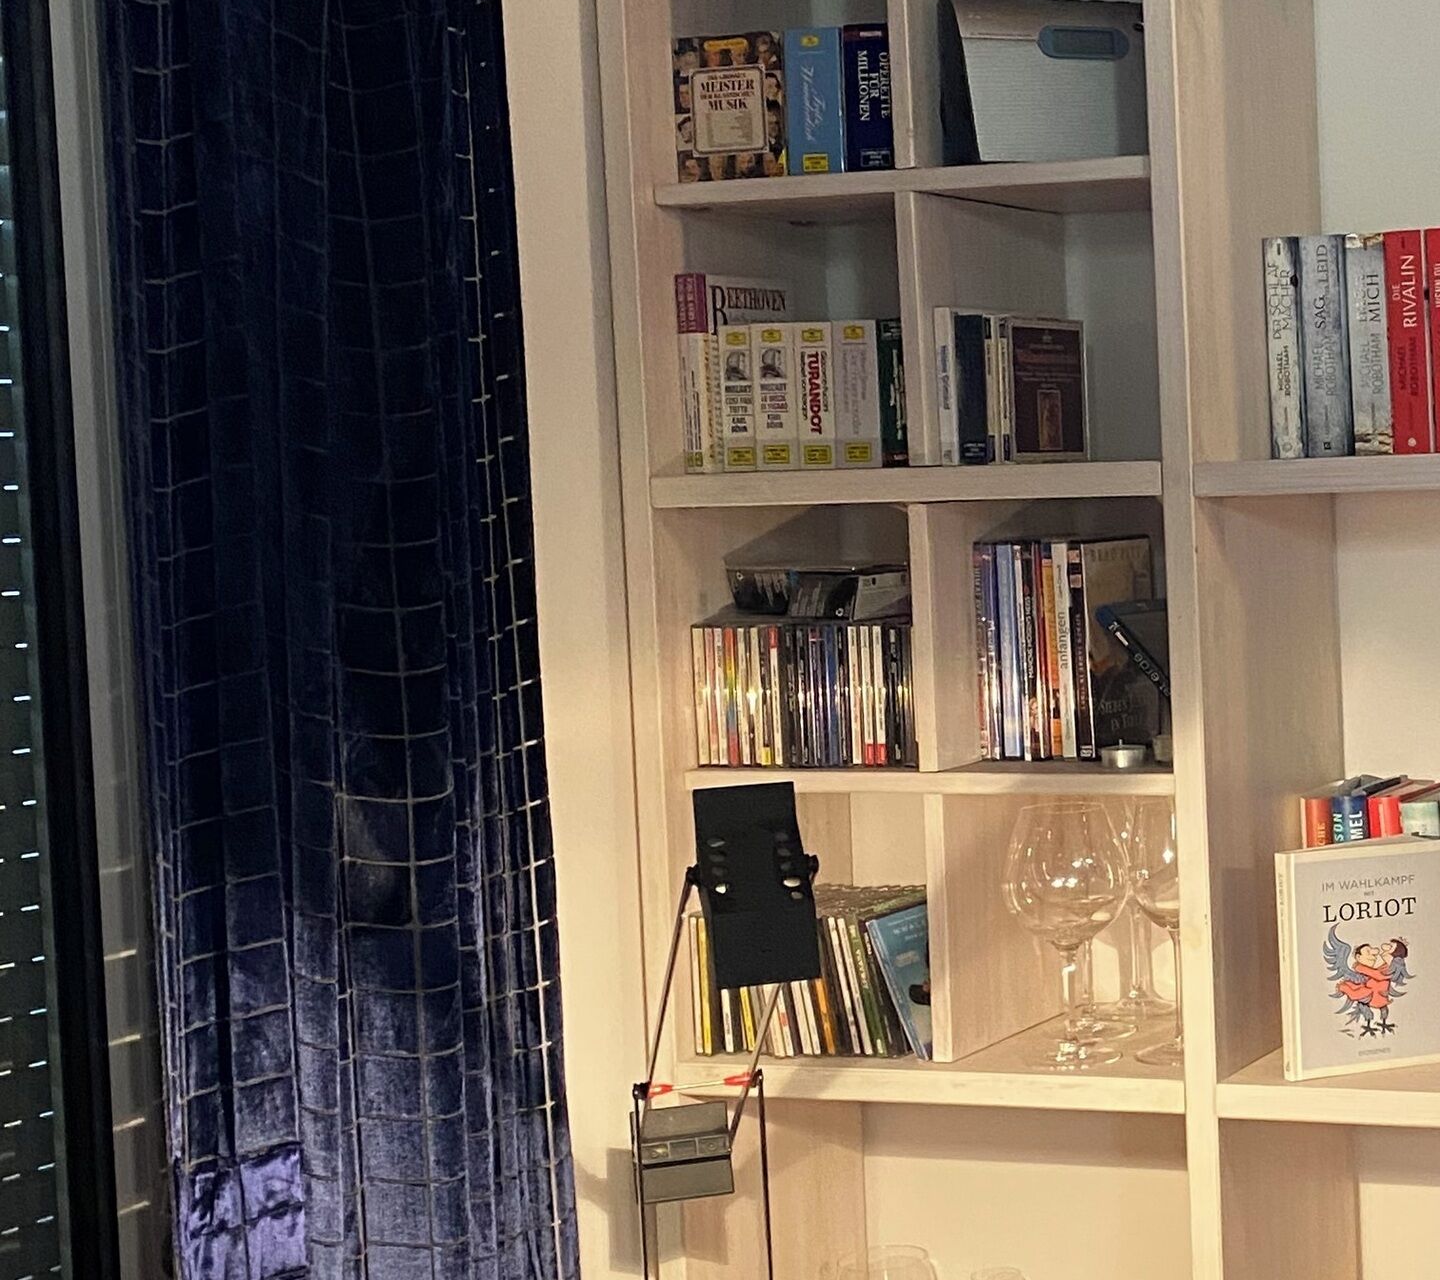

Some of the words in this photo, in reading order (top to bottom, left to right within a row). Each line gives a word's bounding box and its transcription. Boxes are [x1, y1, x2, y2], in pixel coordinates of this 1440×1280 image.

[708, 98, 748, 111] MUSIK
[857, 50, 871, 121] MILLIONEN
[869, 72, 879, 99] FÜR
[1317, 245, 1329, 282] LEID
[1367, 274, 1381, 322] MICH
[1400, 255, 1417, 327] RIVALIN
[807, 351, 823, 435] TURANDOT
[1056, 611, 1070, 669] anfangen
[1322, 881, 1334, 892] IM
[1338, 875, 1415, 891] WAHLKAMPF
[1323, 896, 1416, 923] LORIOT
